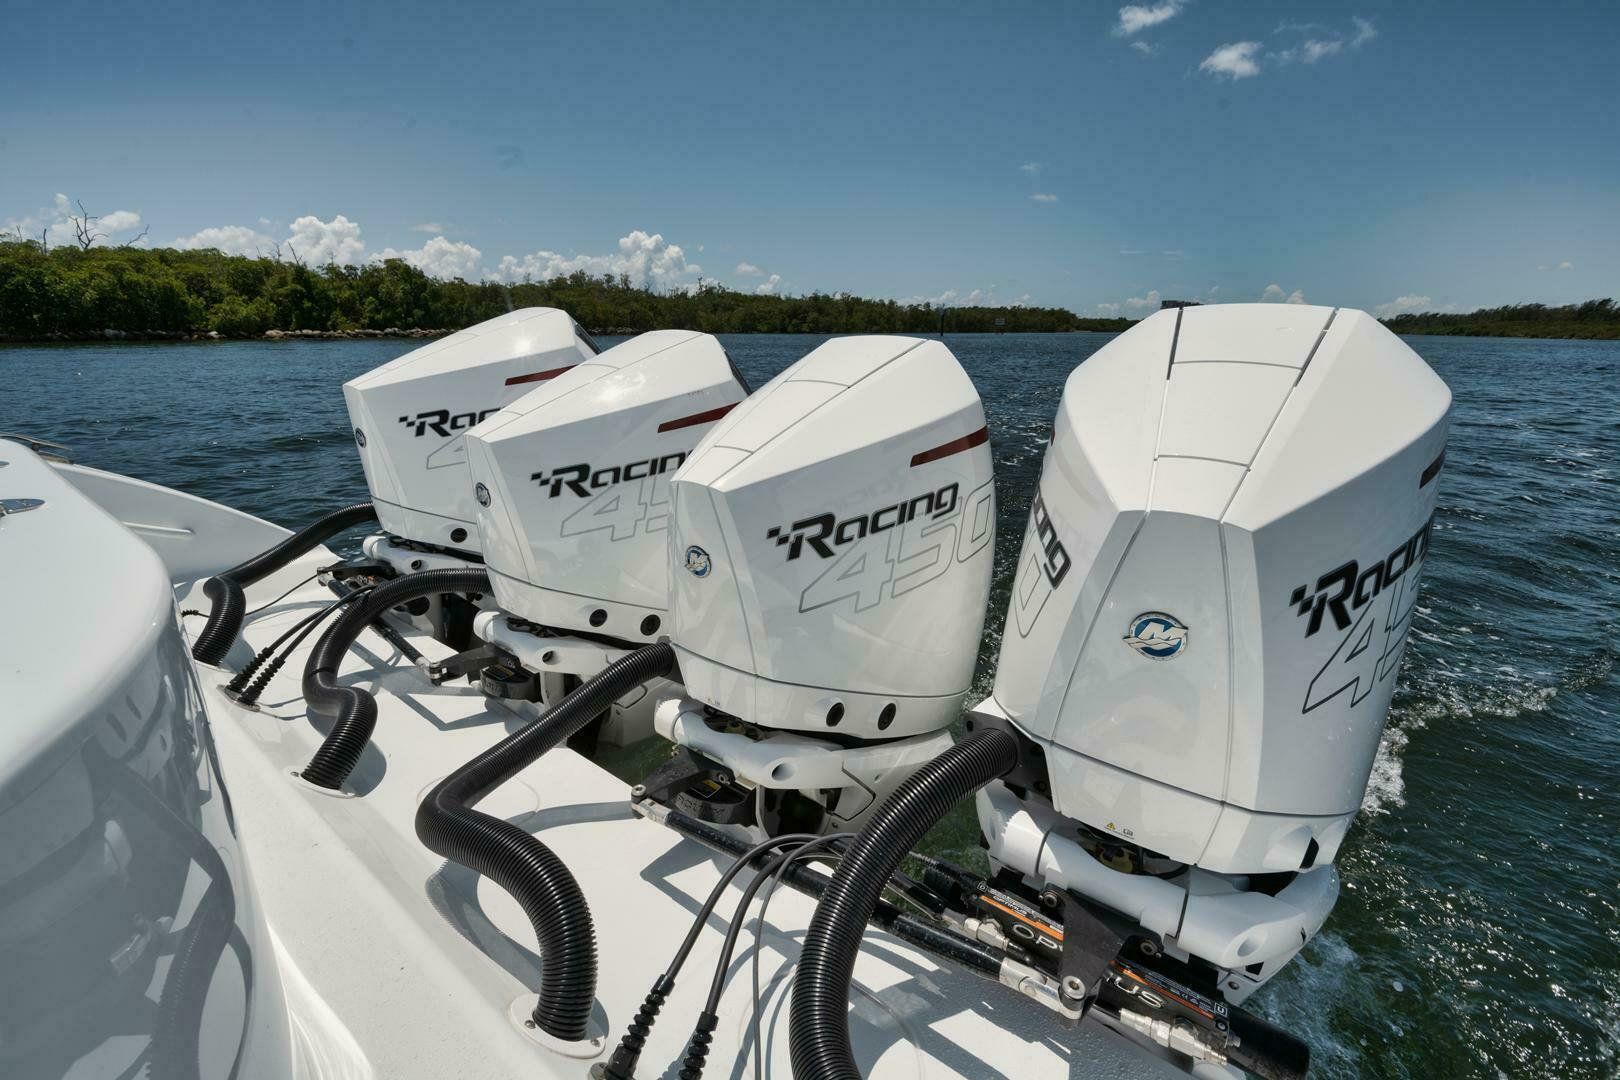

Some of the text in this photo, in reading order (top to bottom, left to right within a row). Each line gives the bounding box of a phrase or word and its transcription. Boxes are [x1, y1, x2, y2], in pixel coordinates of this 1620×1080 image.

[548, 449, 694, 499] Racin
[786, 482, 960, 561] Racing
[798, 475, 996, 614] 450
[1304, 520, 1433, 639] Racin
